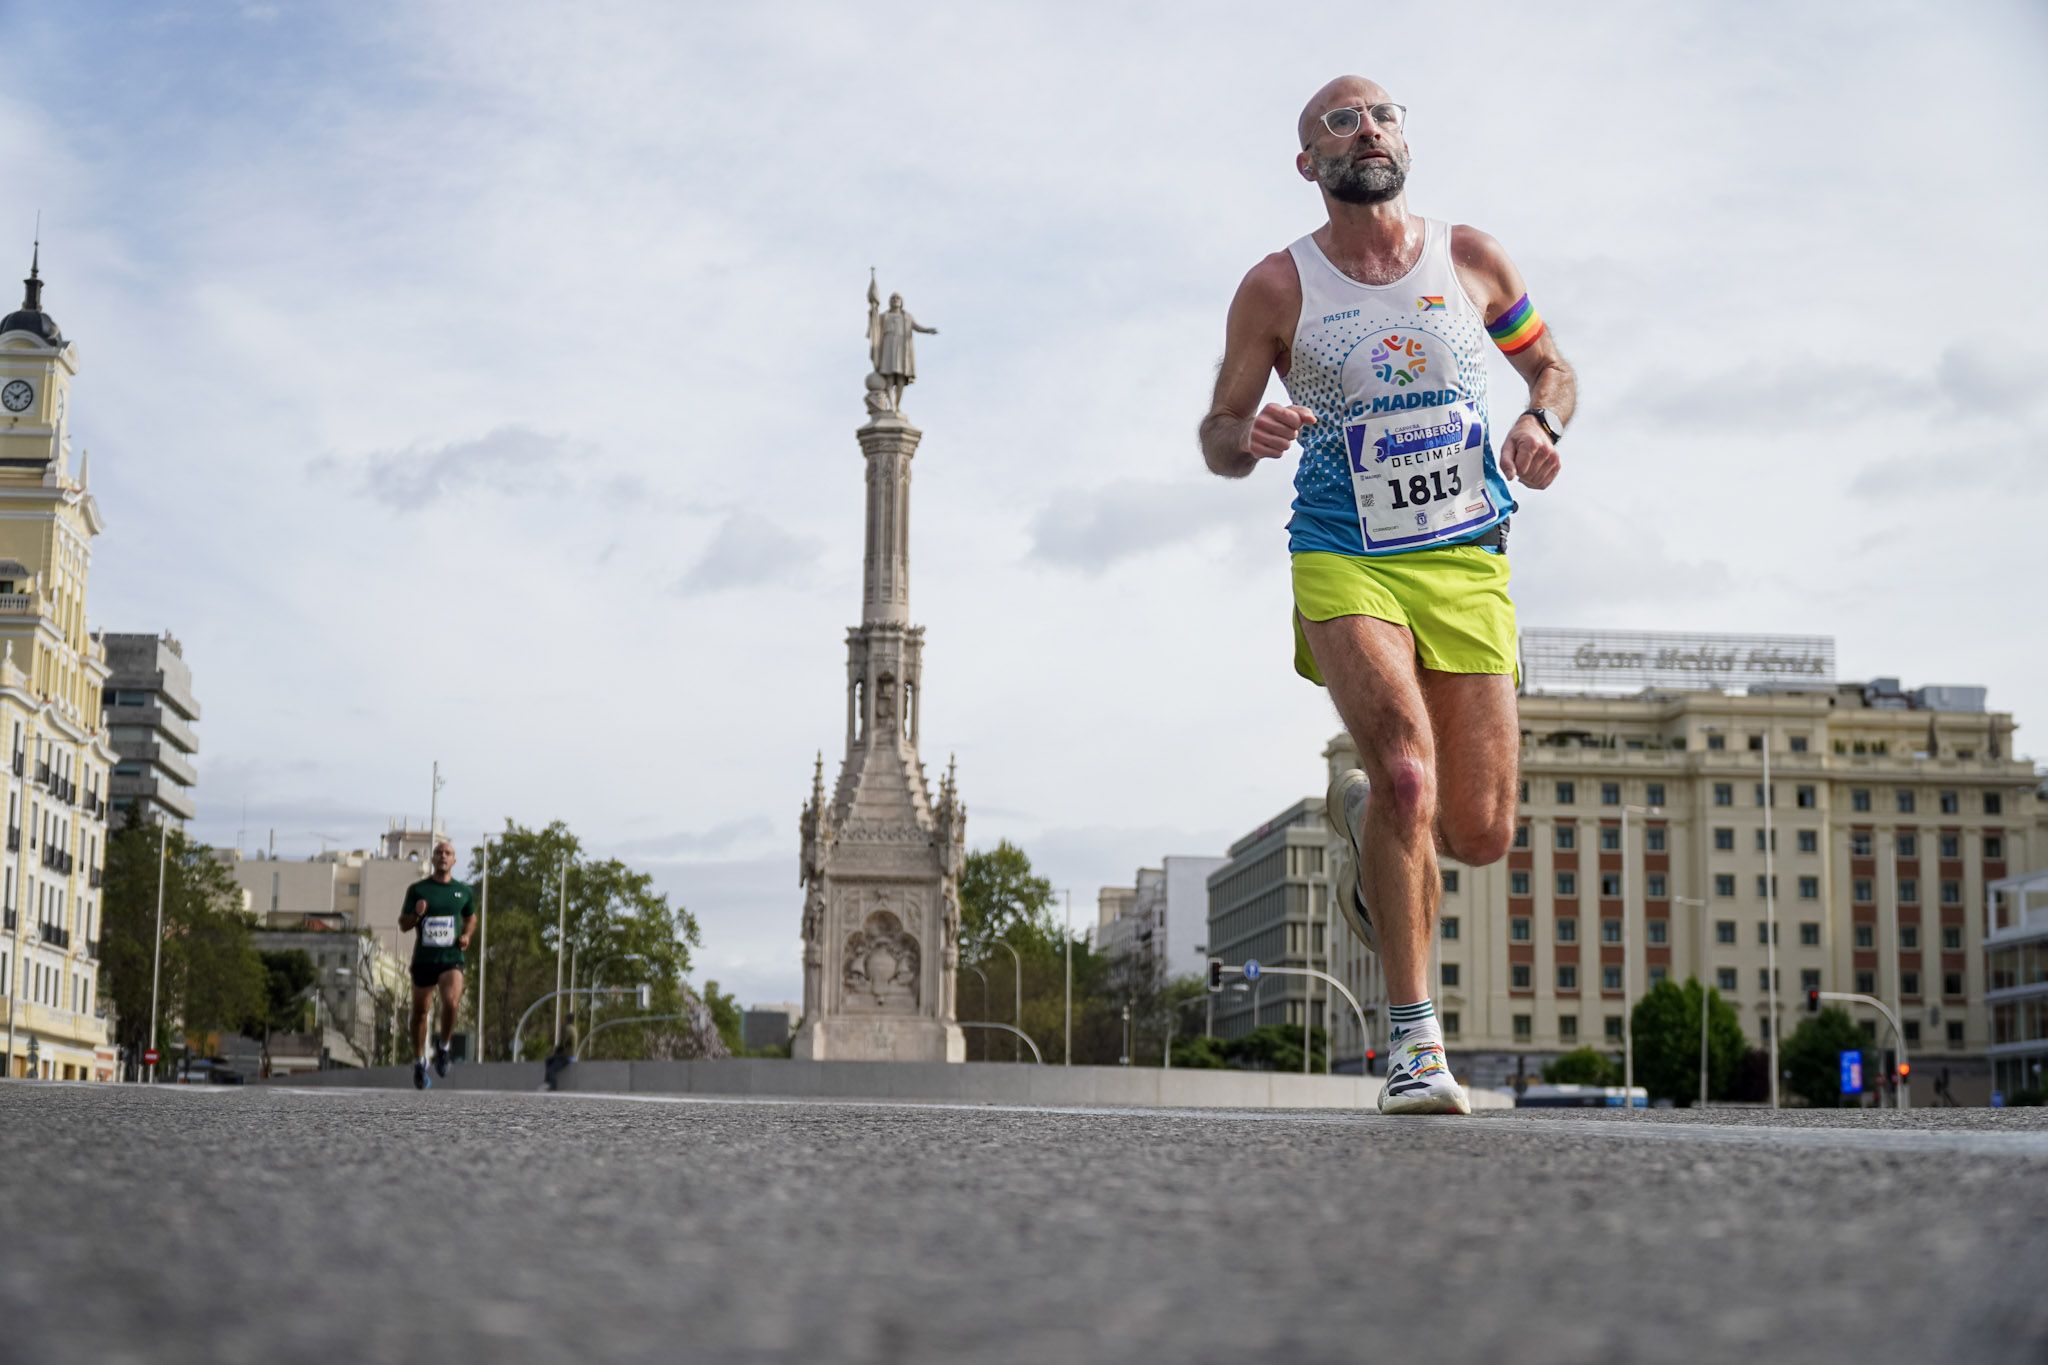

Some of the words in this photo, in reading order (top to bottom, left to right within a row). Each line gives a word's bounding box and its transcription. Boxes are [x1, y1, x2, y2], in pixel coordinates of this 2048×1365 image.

[1323, 309, 1361, 325] FASTER
[1395, 421, 1462, 445] BOMBEROS
[1435, 430, 1462, 447] MADRID
[1391, 443, 1462, 469] DECIMAS
[1387, 463, 1463, 510] 1813
[1575, 642, 1644, 669] Gran
